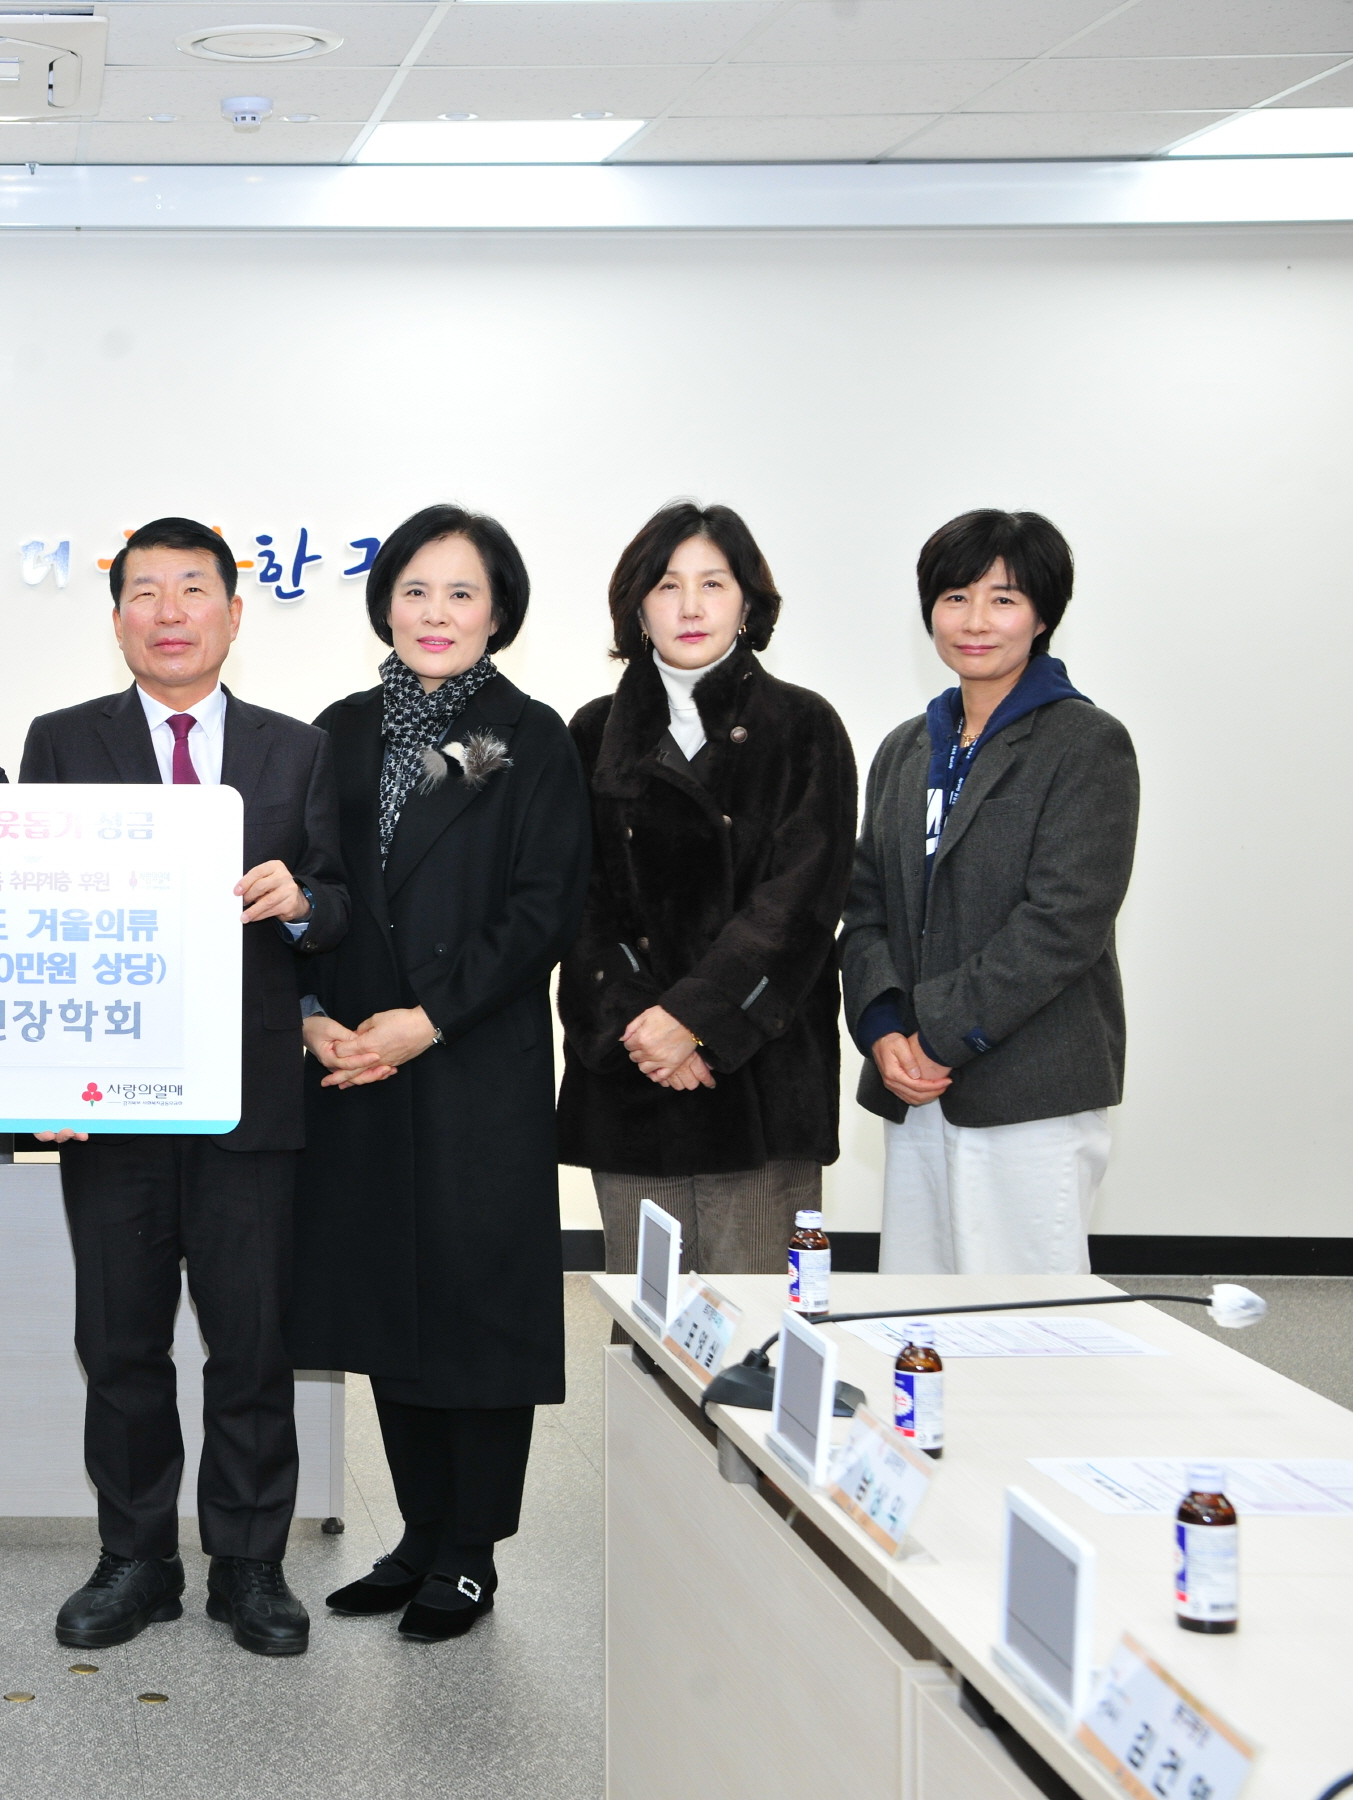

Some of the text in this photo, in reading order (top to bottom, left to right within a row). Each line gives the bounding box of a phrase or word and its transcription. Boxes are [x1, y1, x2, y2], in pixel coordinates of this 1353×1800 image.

[20, 539, 71, 588] 더
[94, 810, 155, 840] 성금
[9, 870, 73, 893] 취약계층
[77, 870, 111, 893] 후원
[26, 907, 159, 943] 겨울의류
[91, 951, 168, 986] 상당)
[106, 1083, 183, 1100] 사랑의열매
